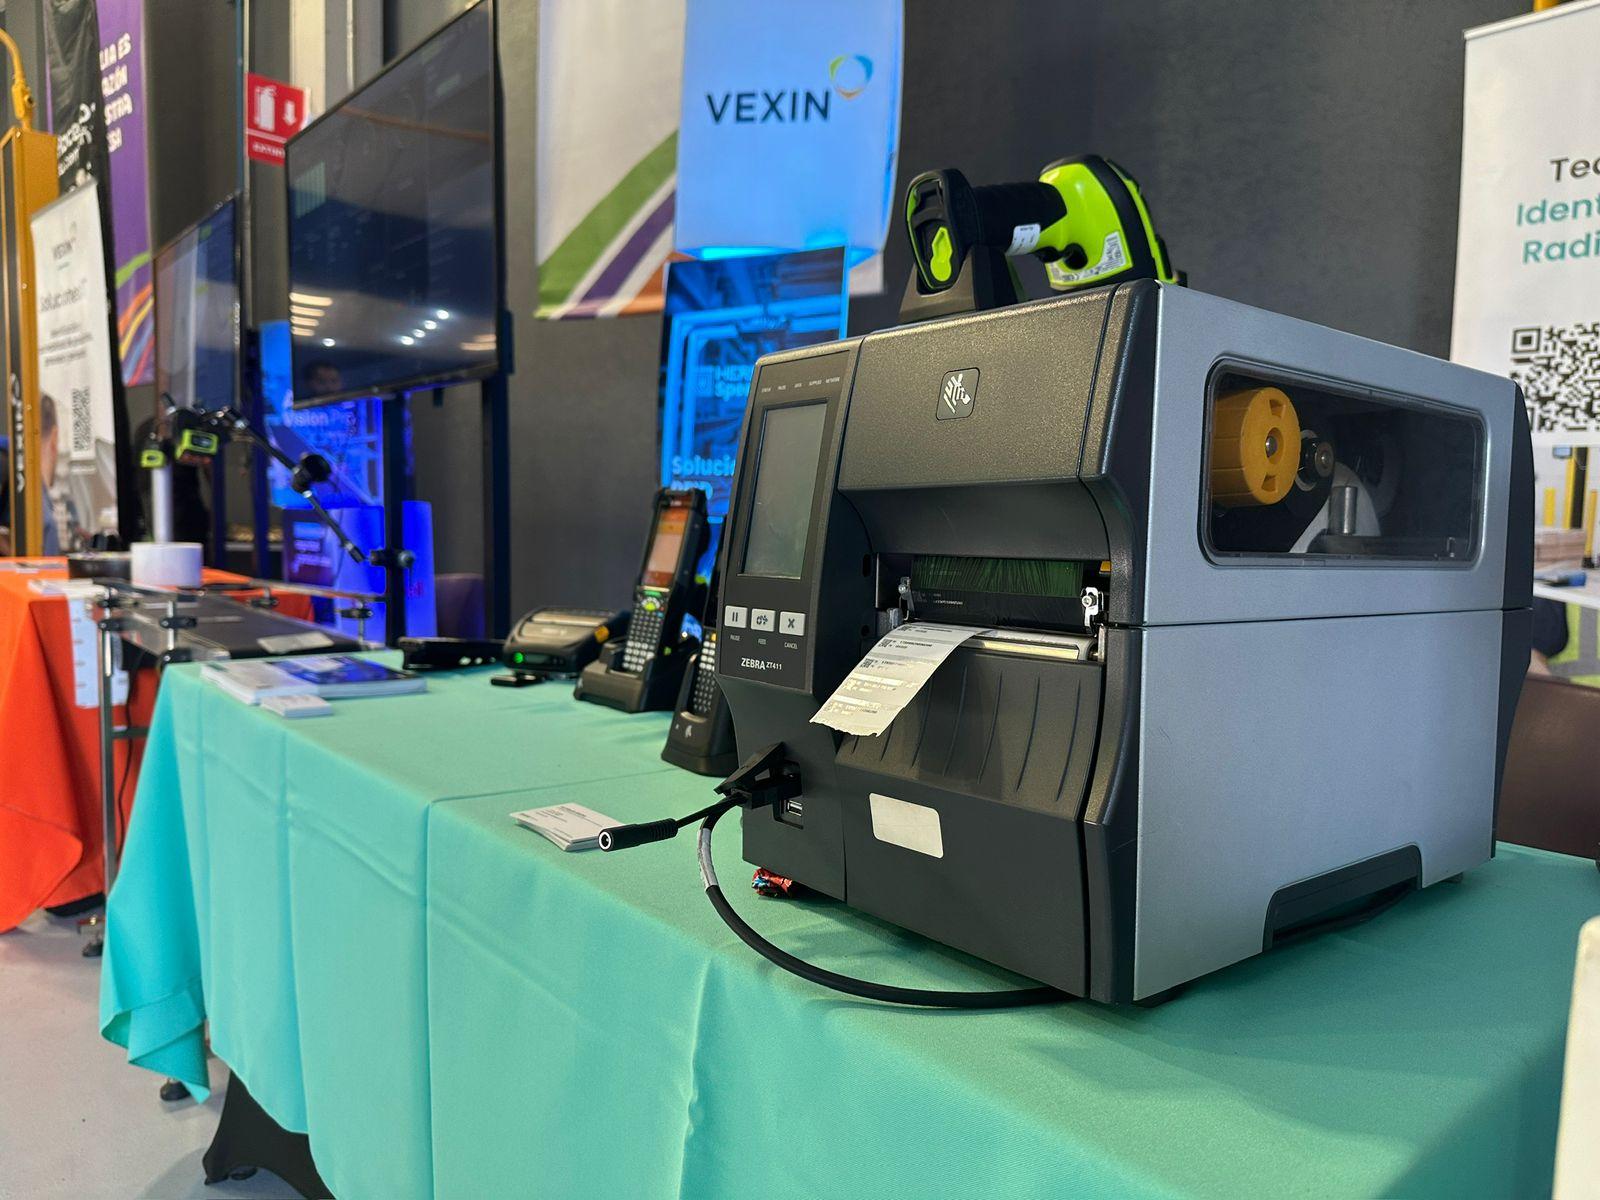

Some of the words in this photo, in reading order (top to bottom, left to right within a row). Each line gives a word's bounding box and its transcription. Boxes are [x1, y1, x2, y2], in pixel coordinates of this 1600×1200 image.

[706, 89, 832, 124] VEXIN
[671, 454, 736, 477] Soluci
[784, 642, 798, 650] CANCEL
[740, 657, 766, 670] ZEBRA
[766, 661, 782, 670] ZT411
